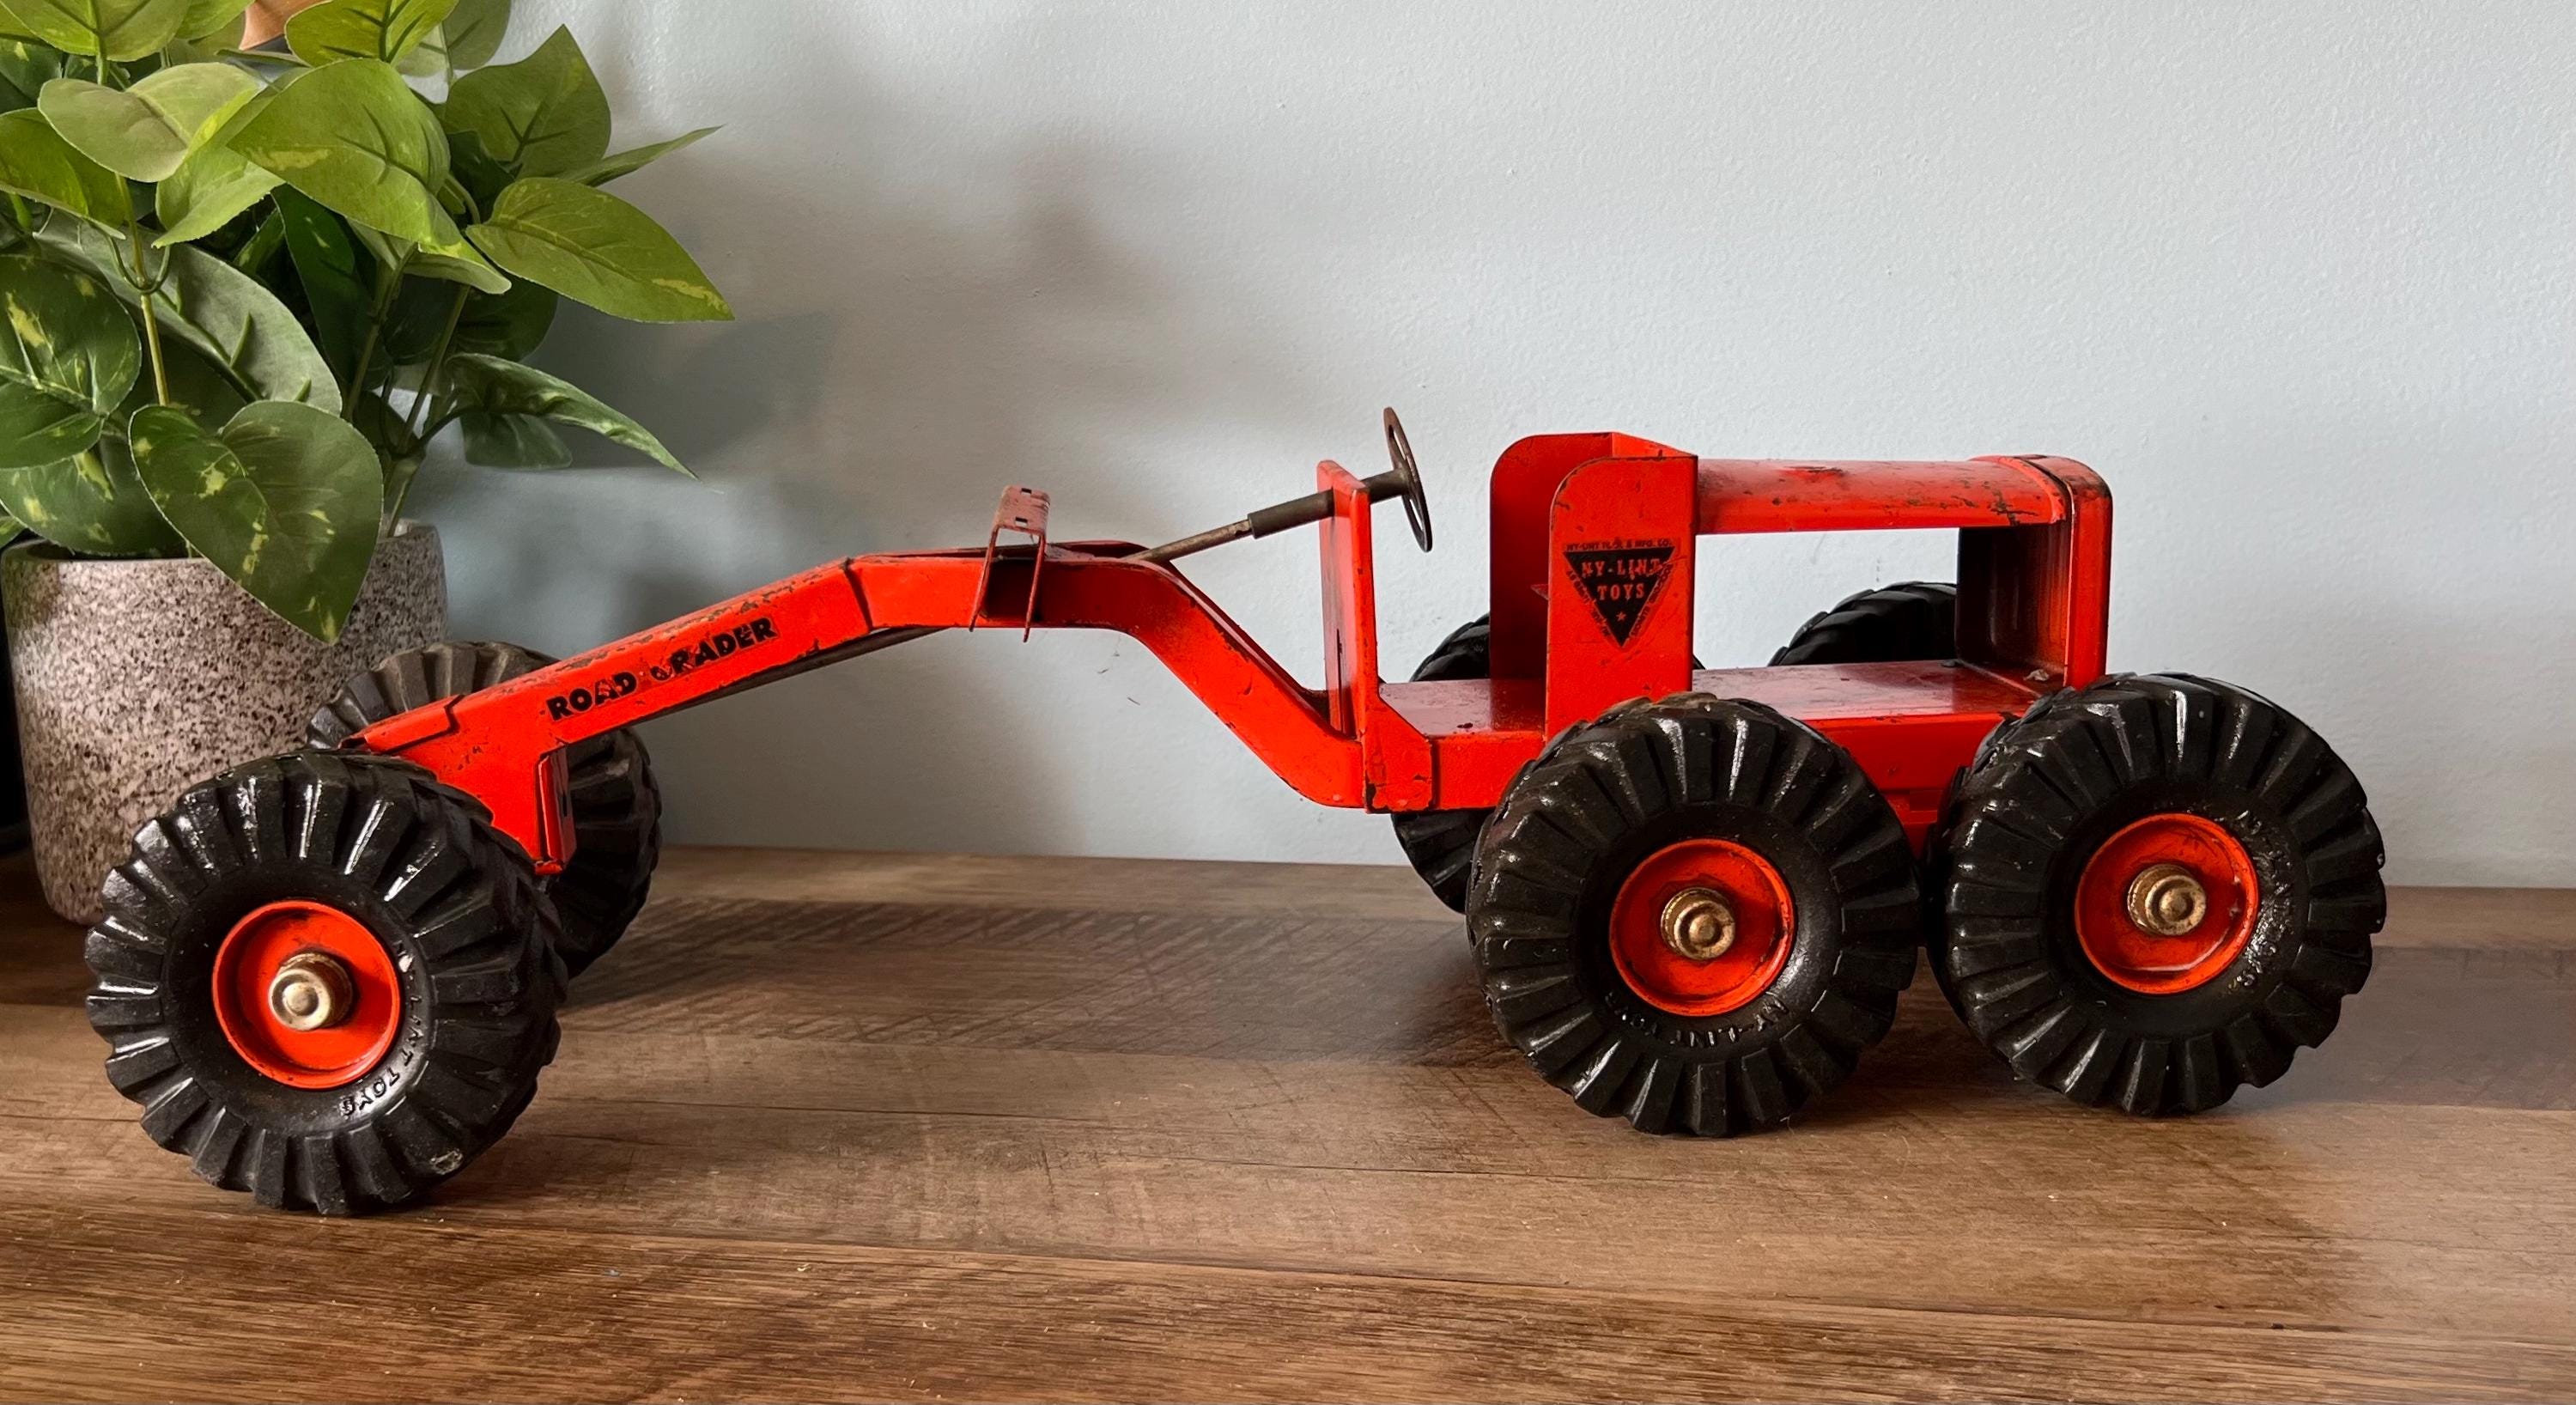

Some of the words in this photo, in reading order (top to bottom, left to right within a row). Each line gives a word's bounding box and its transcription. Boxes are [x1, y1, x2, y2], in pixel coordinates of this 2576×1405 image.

[1581, 558, 1664, 579] NY-LINT
[1597, 583, 1645, 601] TOYS
[545, 671, 639, 721] ROAD
[392, 940, 426, 1067] N-LINT
[340, 1067, 402, 1119] TOYS
